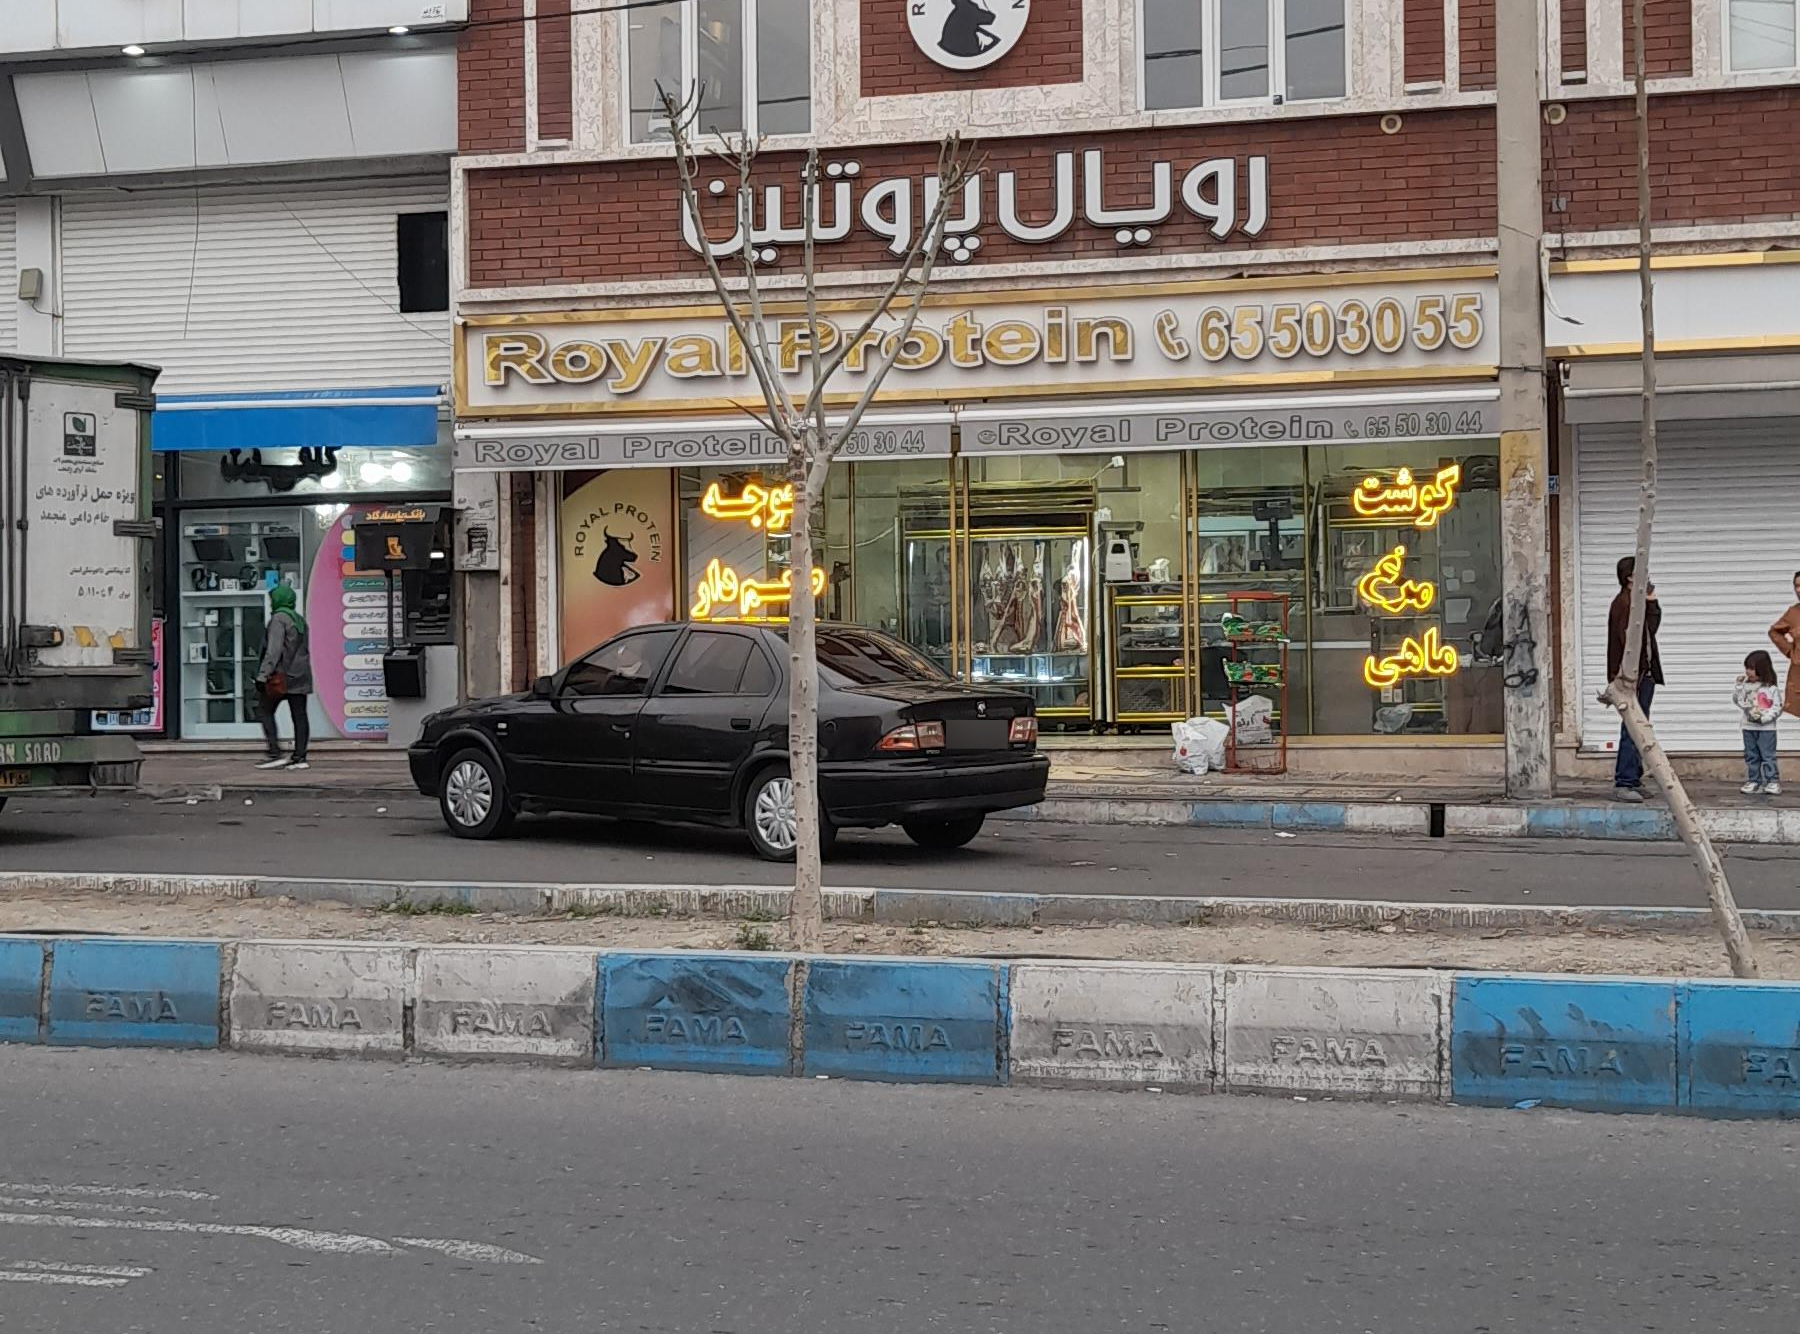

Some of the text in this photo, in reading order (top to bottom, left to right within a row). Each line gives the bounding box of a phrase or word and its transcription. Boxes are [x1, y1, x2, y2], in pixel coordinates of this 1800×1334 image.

[681, 146, 1270, 264] رویال پروتئین
[483, 321, 751, 395] Royal
[776, 305, 1135, 374] Protein
[475, 437, 600, 466] Royal
[622, 432, 788, 460] Protein
[873, 430, 898, 455] 30
[901, 429, 926, 454] 44
[999, 410, 1483, 450] Royal Protein 65 50 30 44
[701, 481, 795, 530] وجه
[1352, 464, 1460, 527] گوشت
[574, 502, 662, 562] ROYAL PROTEIN
[1359, 544, 1435, 613] مرغ
[1364, 626, 1458, 687] ماهی
[266, 1000, 362, 1030] FAMA
[452, 1007, 551, 1036] FAMA
[645, 1014, 749, 1046] FAMA
[845, 1020, 952, 1051] FAMA
[1052, 1027, 1164, 1059] FAMA
[1270, 1034, 1388, 1067] FAMA
